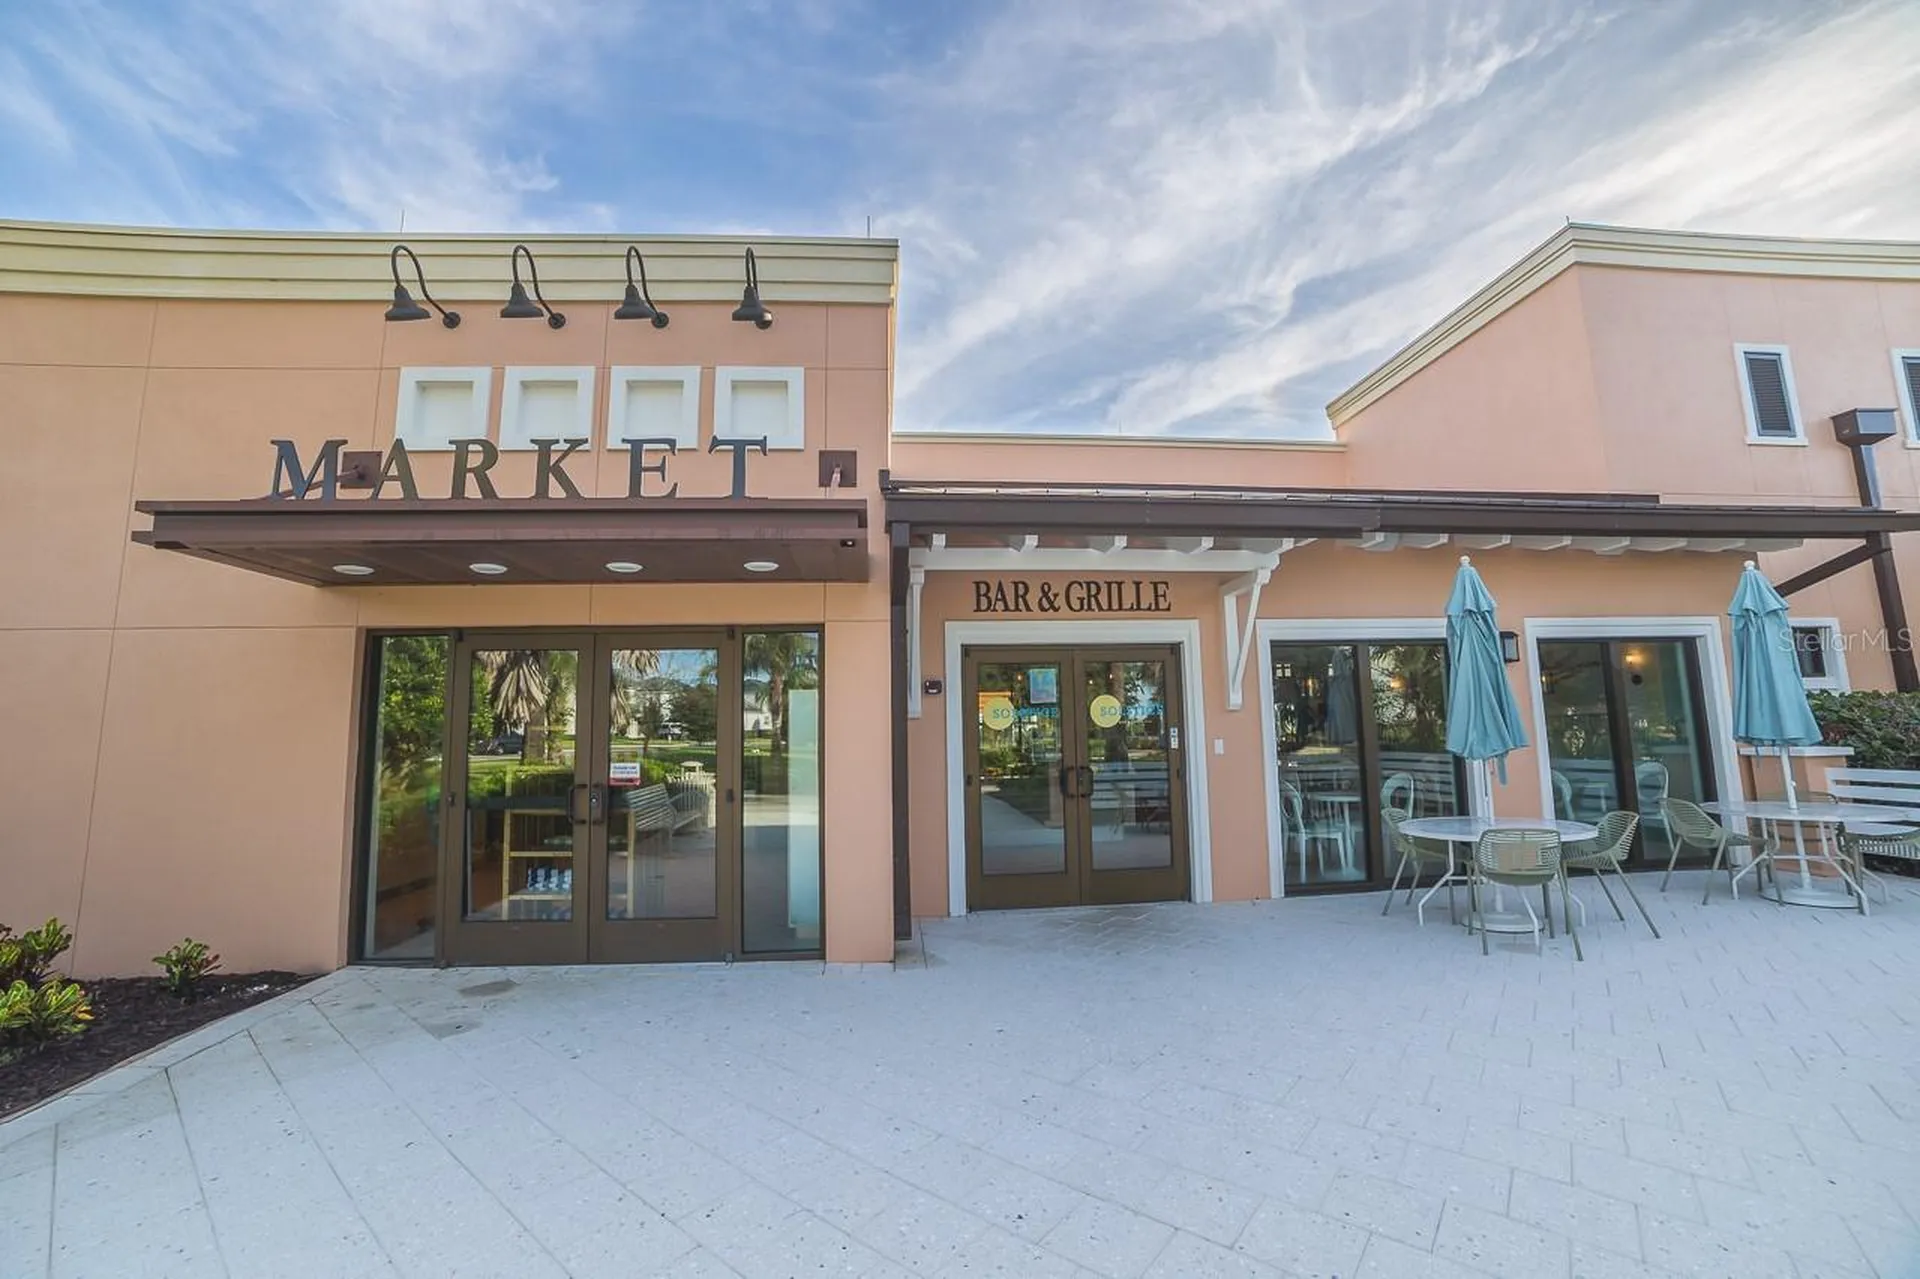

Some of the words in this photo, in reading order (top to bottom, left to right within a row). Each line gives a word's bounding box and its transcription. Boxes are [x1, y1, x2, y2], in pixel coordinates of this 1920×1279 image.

[269, 436, 769, 500] MARKET
[973, 580, 1033, 613] BAR
[1039, 581, 1060, 612] &
[1065, 580, 1172, 612] GRILLE
